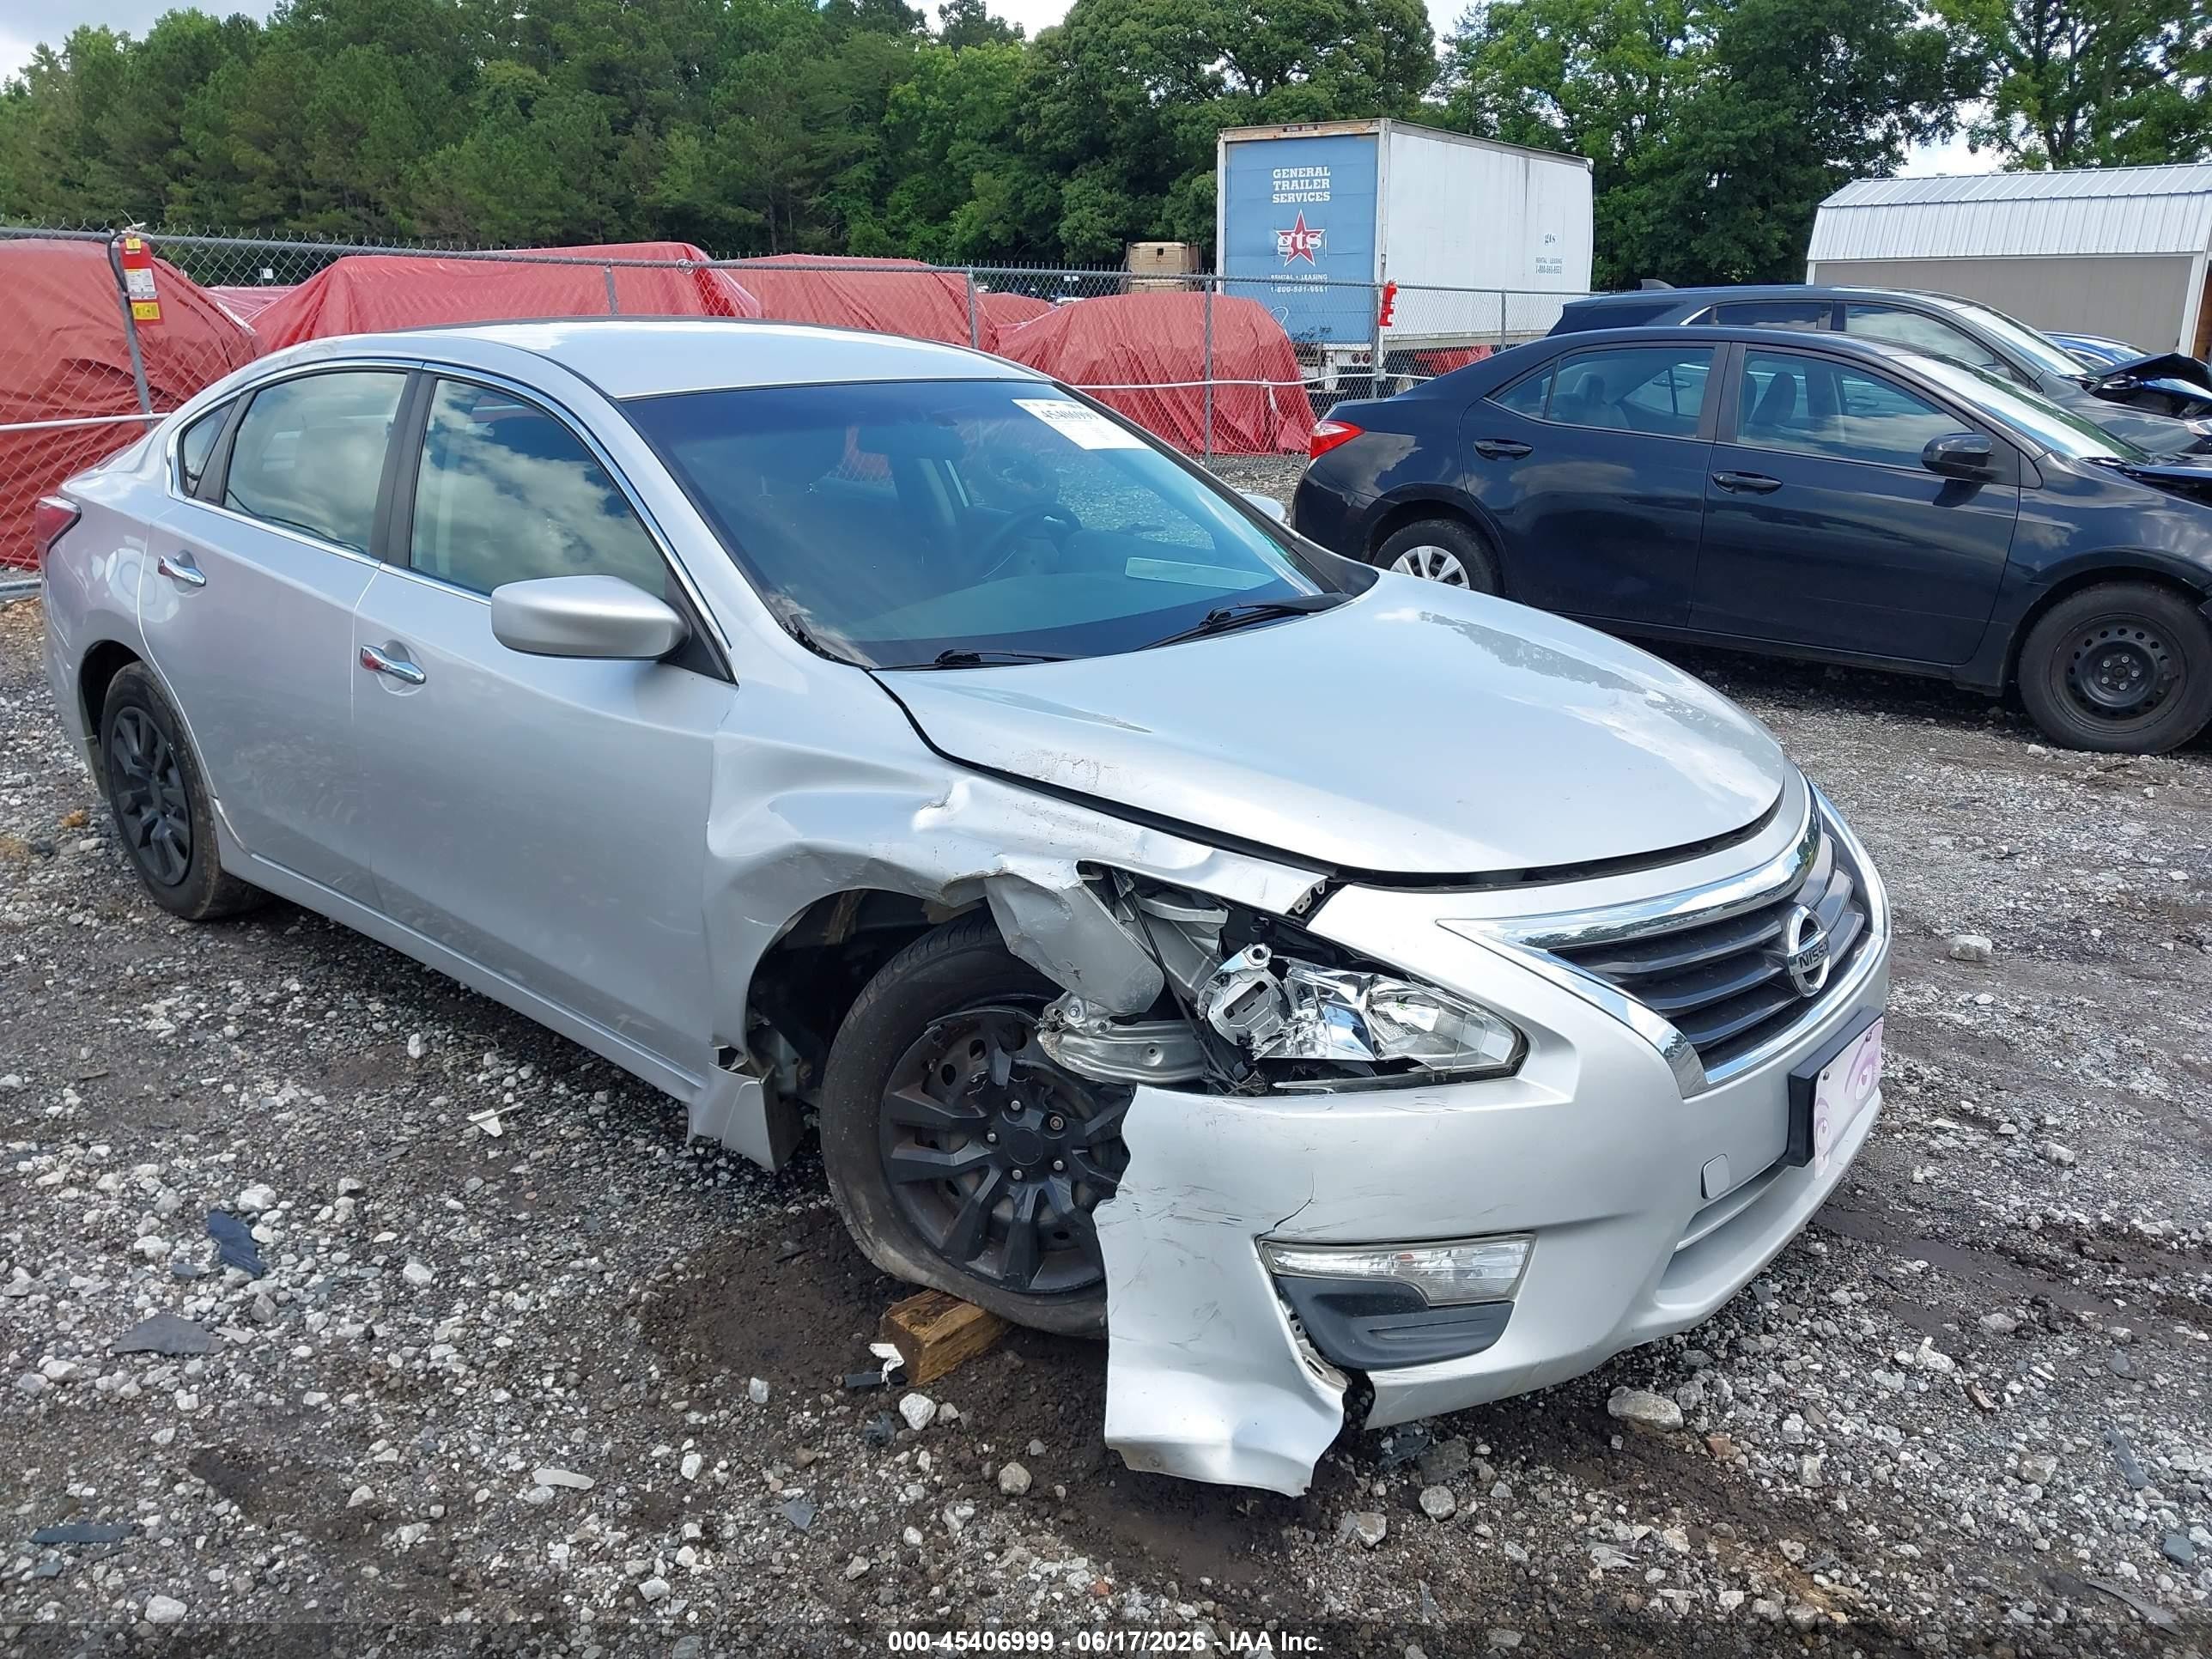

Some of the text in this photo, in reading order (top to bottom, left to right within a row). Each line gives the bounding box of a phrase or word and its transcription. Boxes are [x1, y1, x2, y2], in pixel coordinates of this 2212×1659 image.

[1273, 167, 1331, 179] GENERAL
[1273, 179, 1330, 191] TRAILER
[1273, 191, 1331, 204] SERVICES
[1277, 230, 1322, 257] gts
[1799, 942, 1828, 969] NISSA
